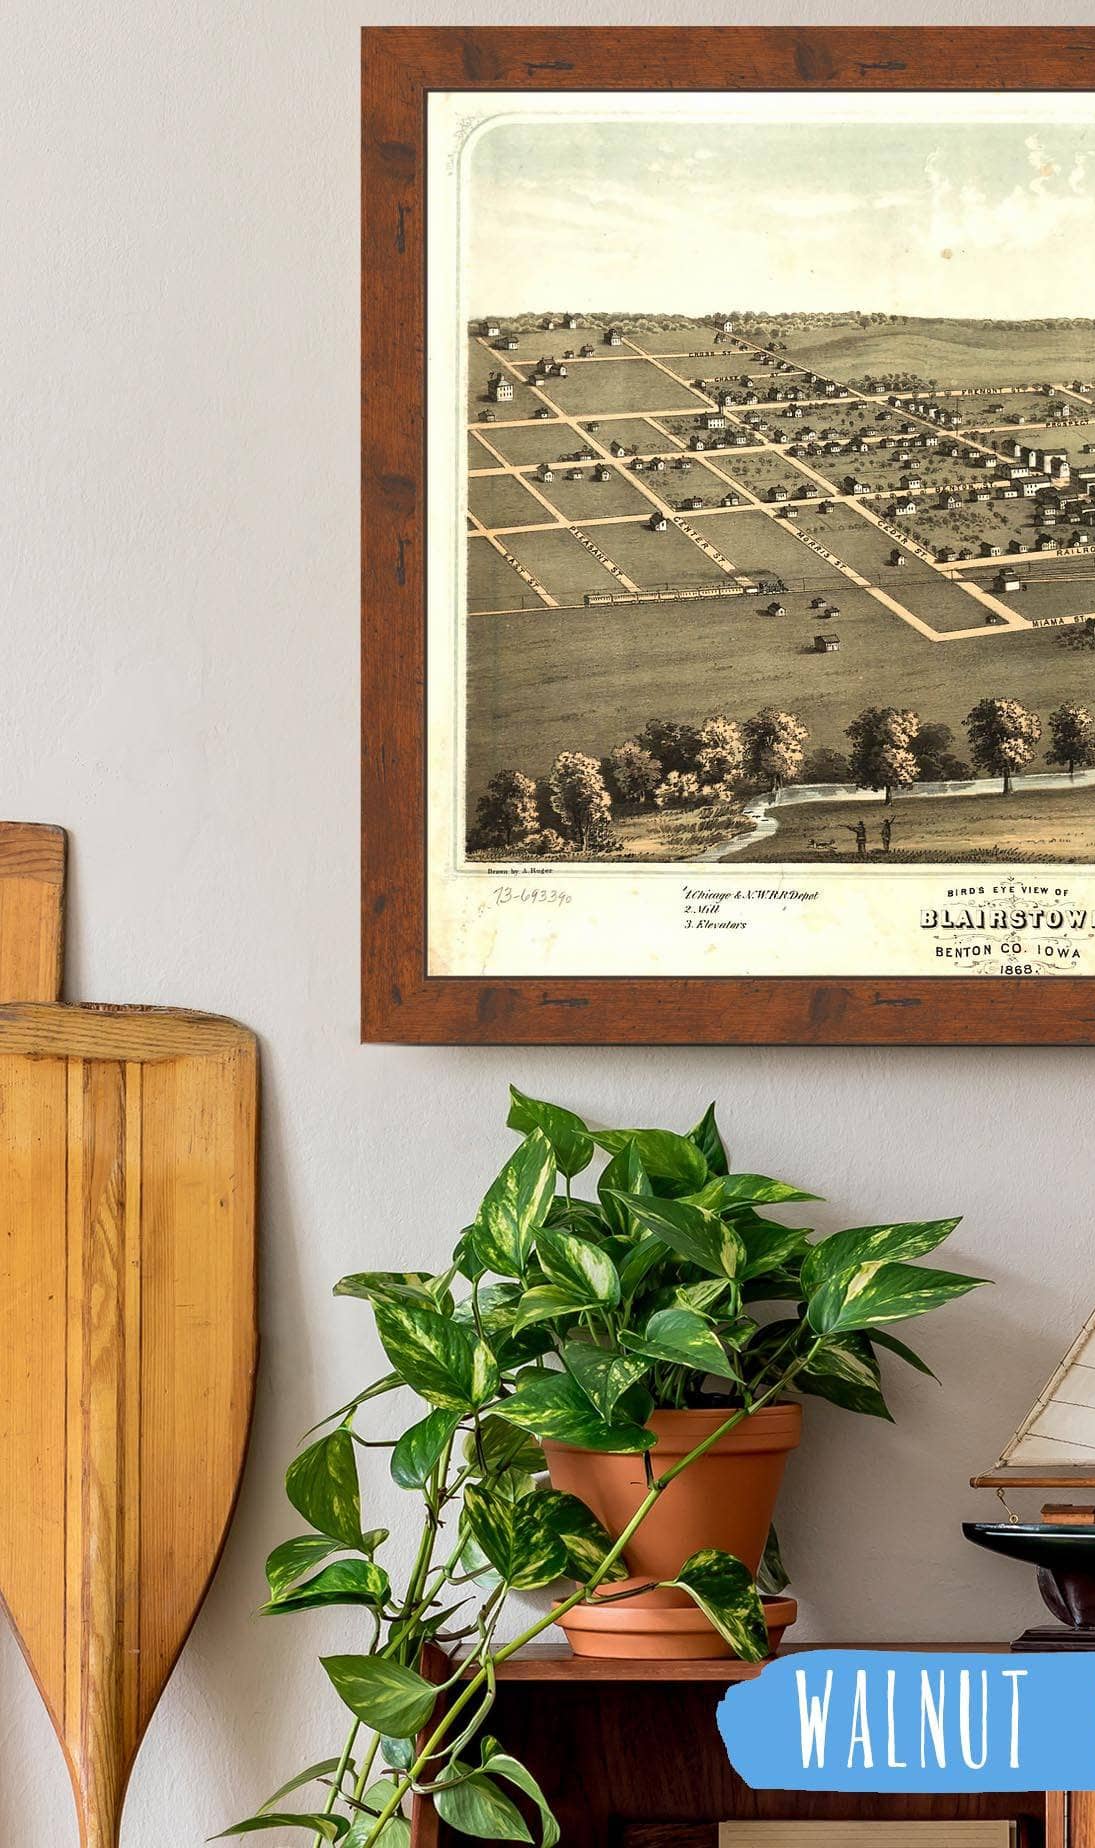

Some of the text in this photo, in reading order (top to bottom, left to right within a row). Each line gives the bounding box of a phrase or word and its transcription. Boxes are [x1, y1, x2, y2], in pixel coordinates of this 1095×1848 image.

[569, 526, 608, 564] PLEASANT
[673, 516, 709, 550] CENTER
[796, 531, 830, 558] MORRIS
[877, 520, 908, 545] CEDAR
[1032, 617, 1064, 628] MIAMA
[947, 886, 1069, 897] BIRDS EYE VIEW OF
[936, 942, 1081, 958] BENTON CO. IOWA
